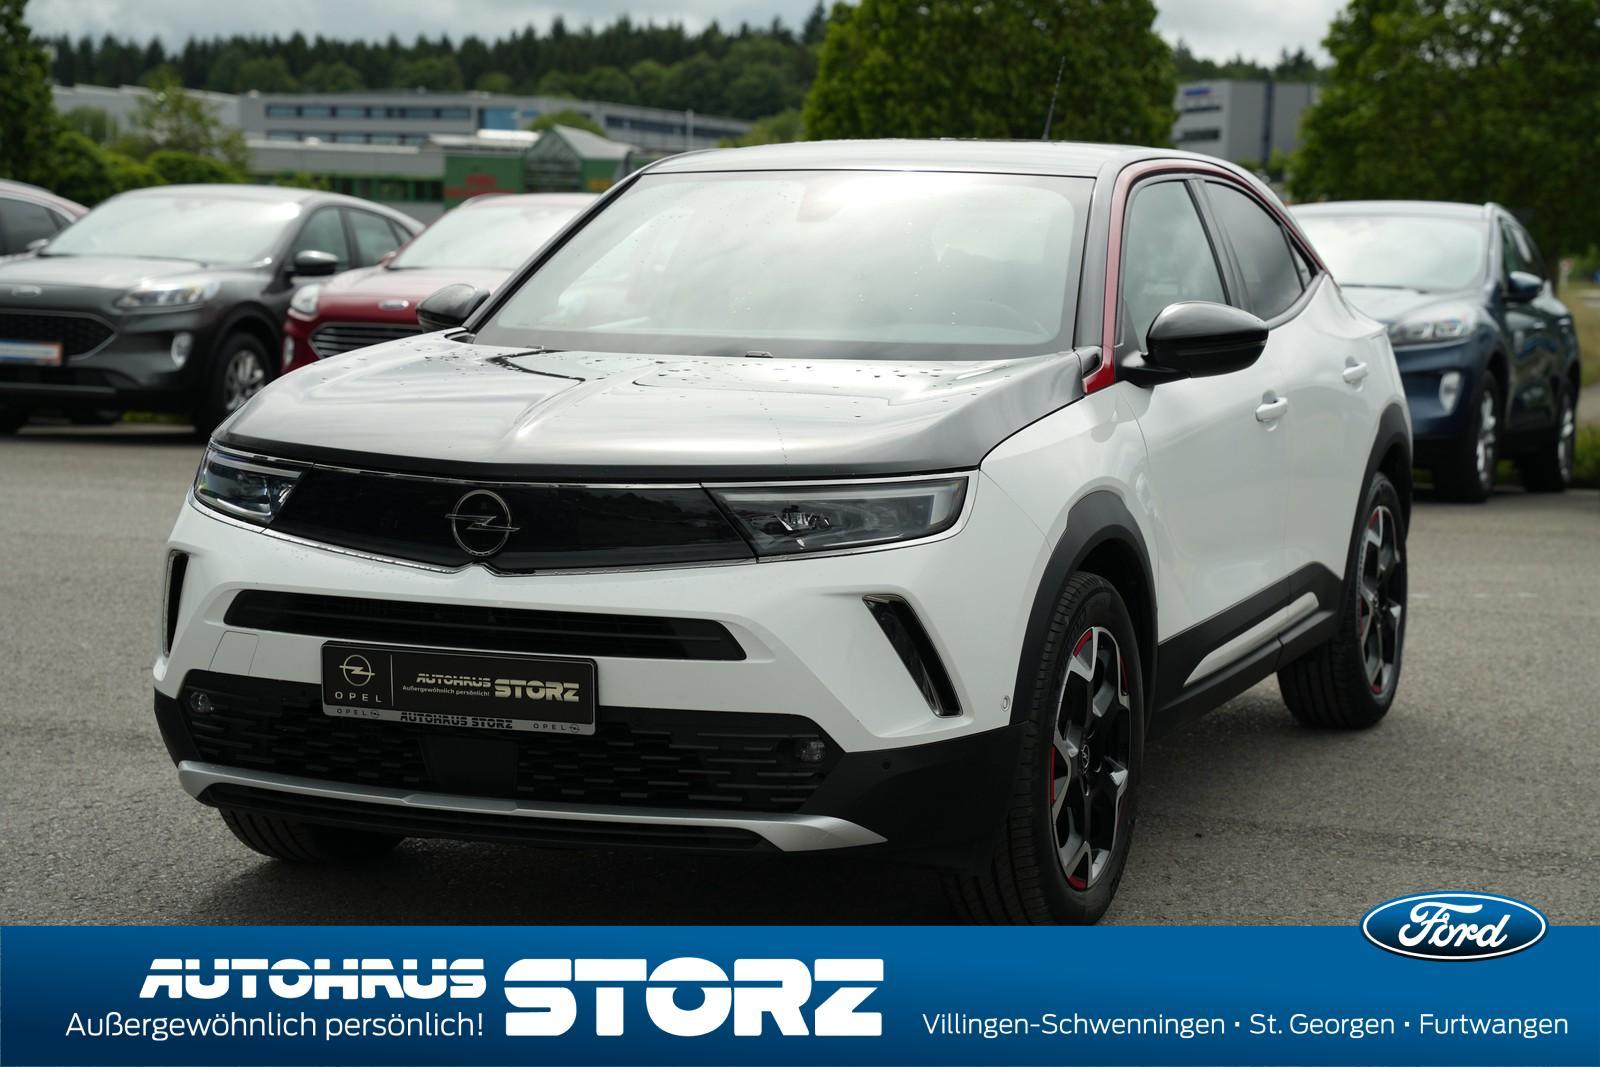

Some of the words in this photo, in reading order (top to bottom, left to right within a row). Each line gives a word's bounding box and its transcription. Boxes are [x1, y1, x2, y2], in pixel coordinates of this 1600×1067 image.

[416, 673, 491, 687] AUTOHAUS
[334, 690, 383, 703] OPEL
[494, 678, 580, 703] STORZ
[336, 708, 368, 716] OPEL
[400, 711, 469, 727] AUTOHAUS
[471, 718, 513, 729] STORZ
[532, 723, 567, 731] OPEL
